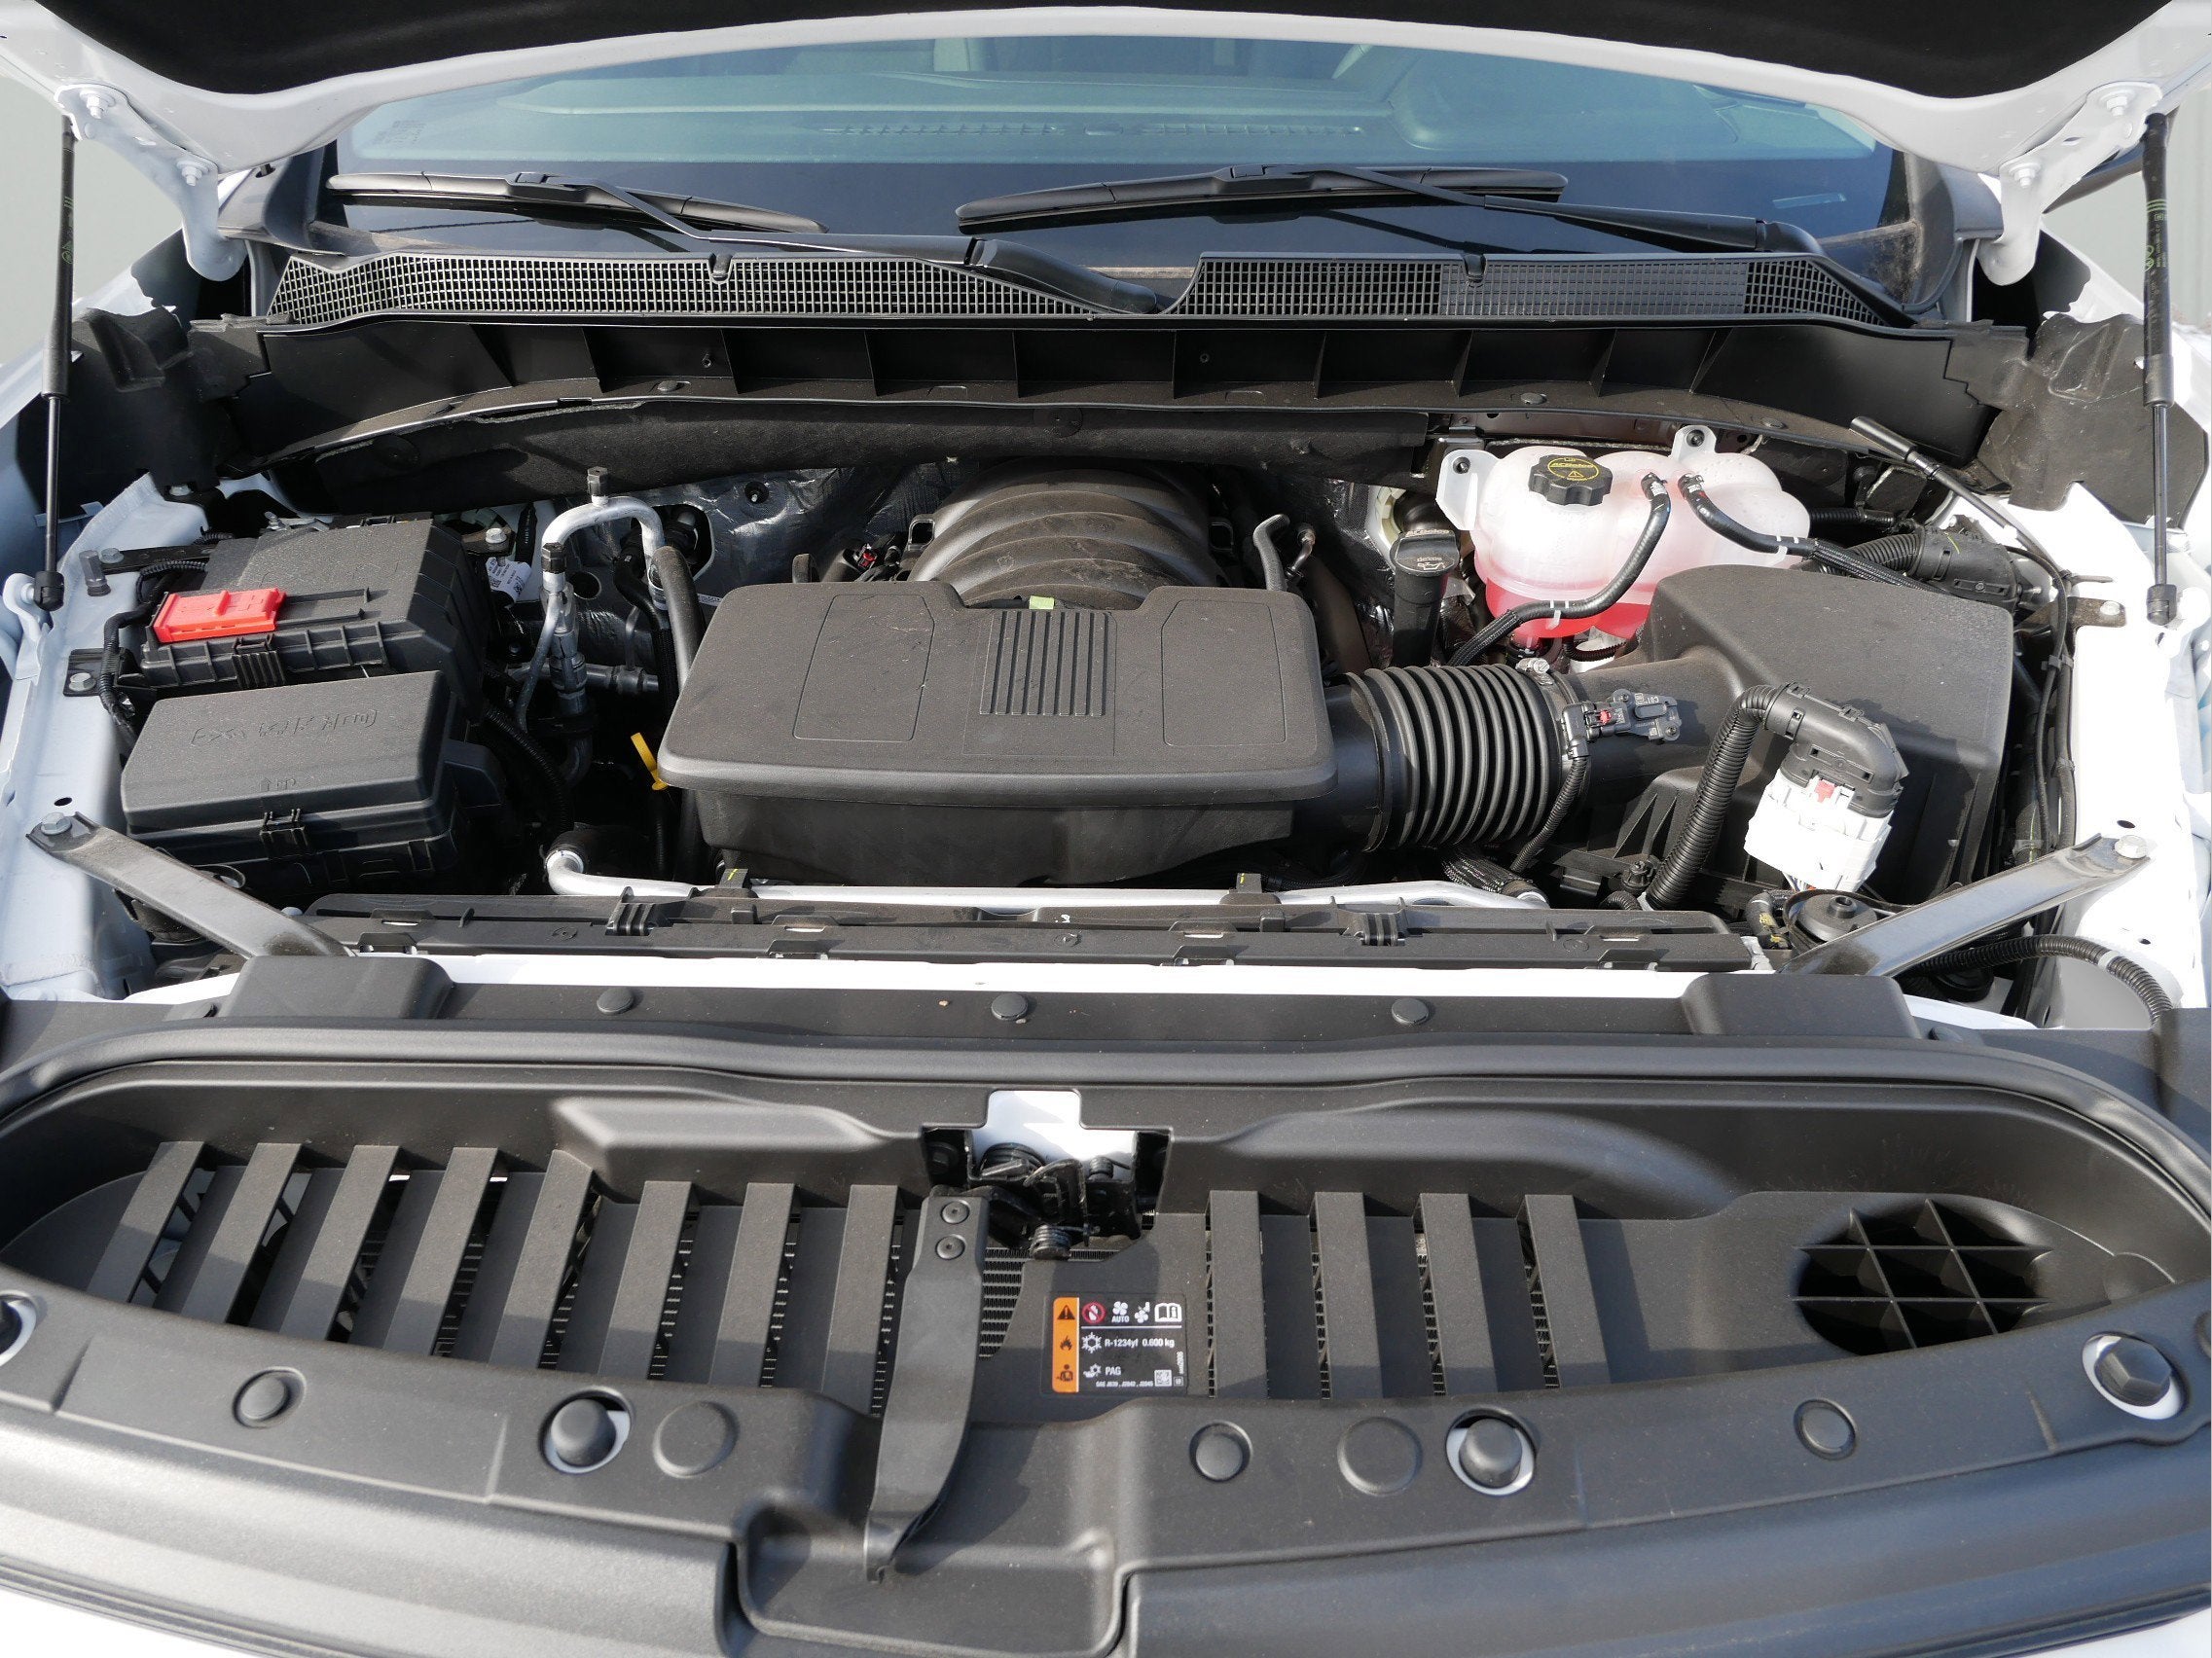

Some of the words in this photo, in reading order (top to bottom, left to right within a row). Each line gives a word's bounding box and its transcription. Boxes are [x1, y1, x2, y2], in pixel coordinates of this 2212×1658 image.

[1105, 1338, 1139, 1349] R-1234yf
[1142, 1338, 1164, 1347] 0.600
[1164, 1338, 1176, 1349] kg
[1105, 1366, 1121, 1376] PAG
